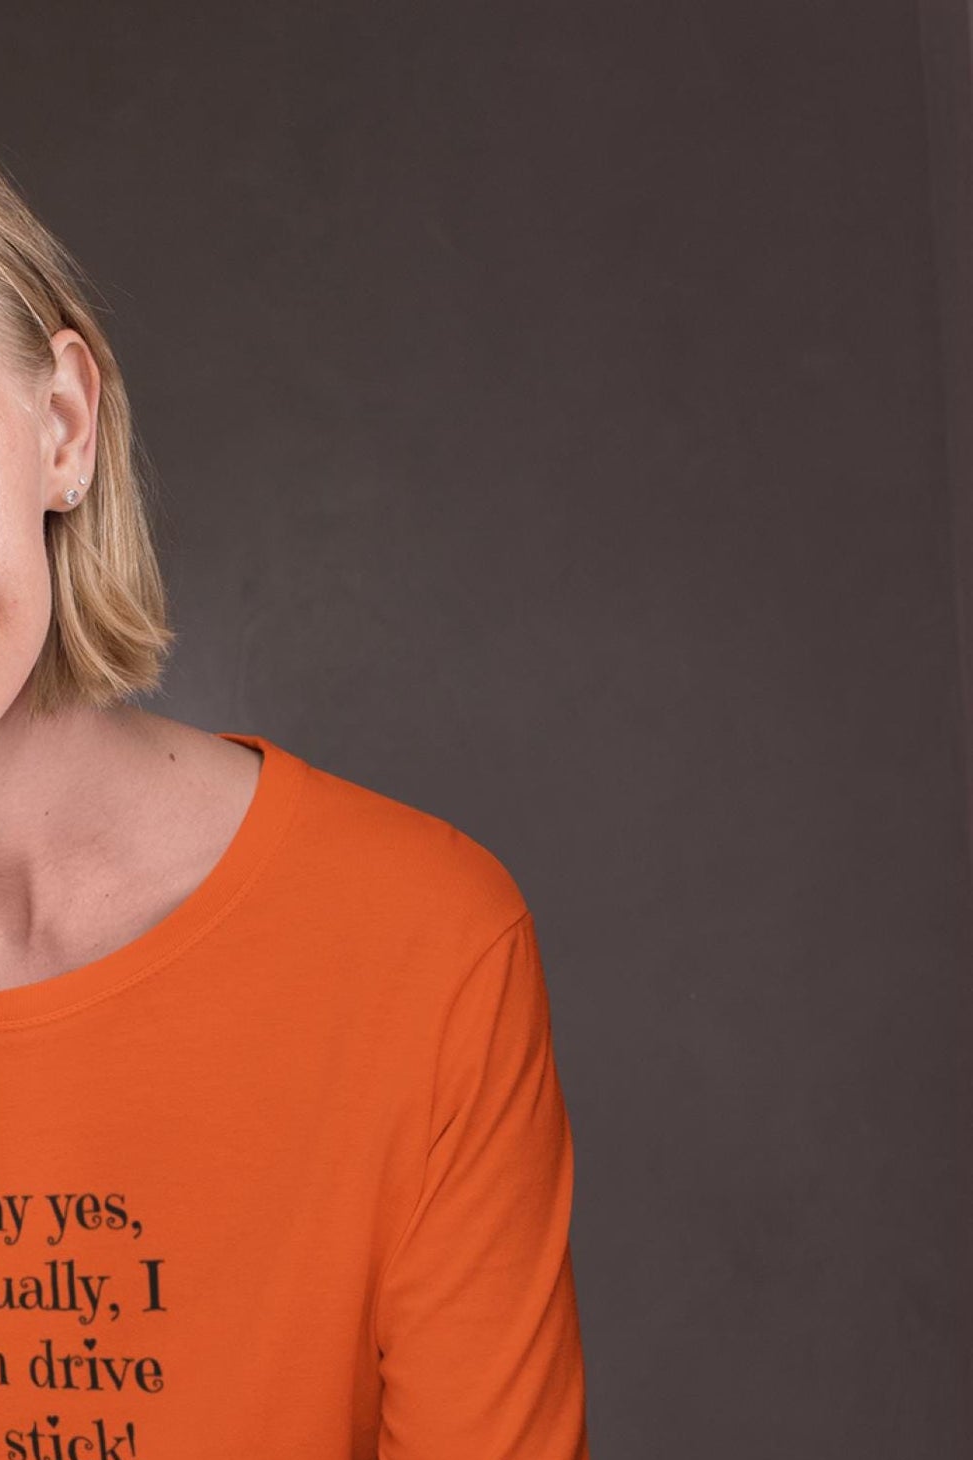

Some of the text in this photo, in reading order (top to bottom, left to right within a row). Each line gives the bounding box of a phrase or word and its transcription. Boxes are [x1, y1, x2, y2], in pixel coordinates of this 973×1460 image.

[44, 1192, 143, 1246] yes,
[139, 1259, 168, 1313] I
[29, 1338, 165, 1394] drive
